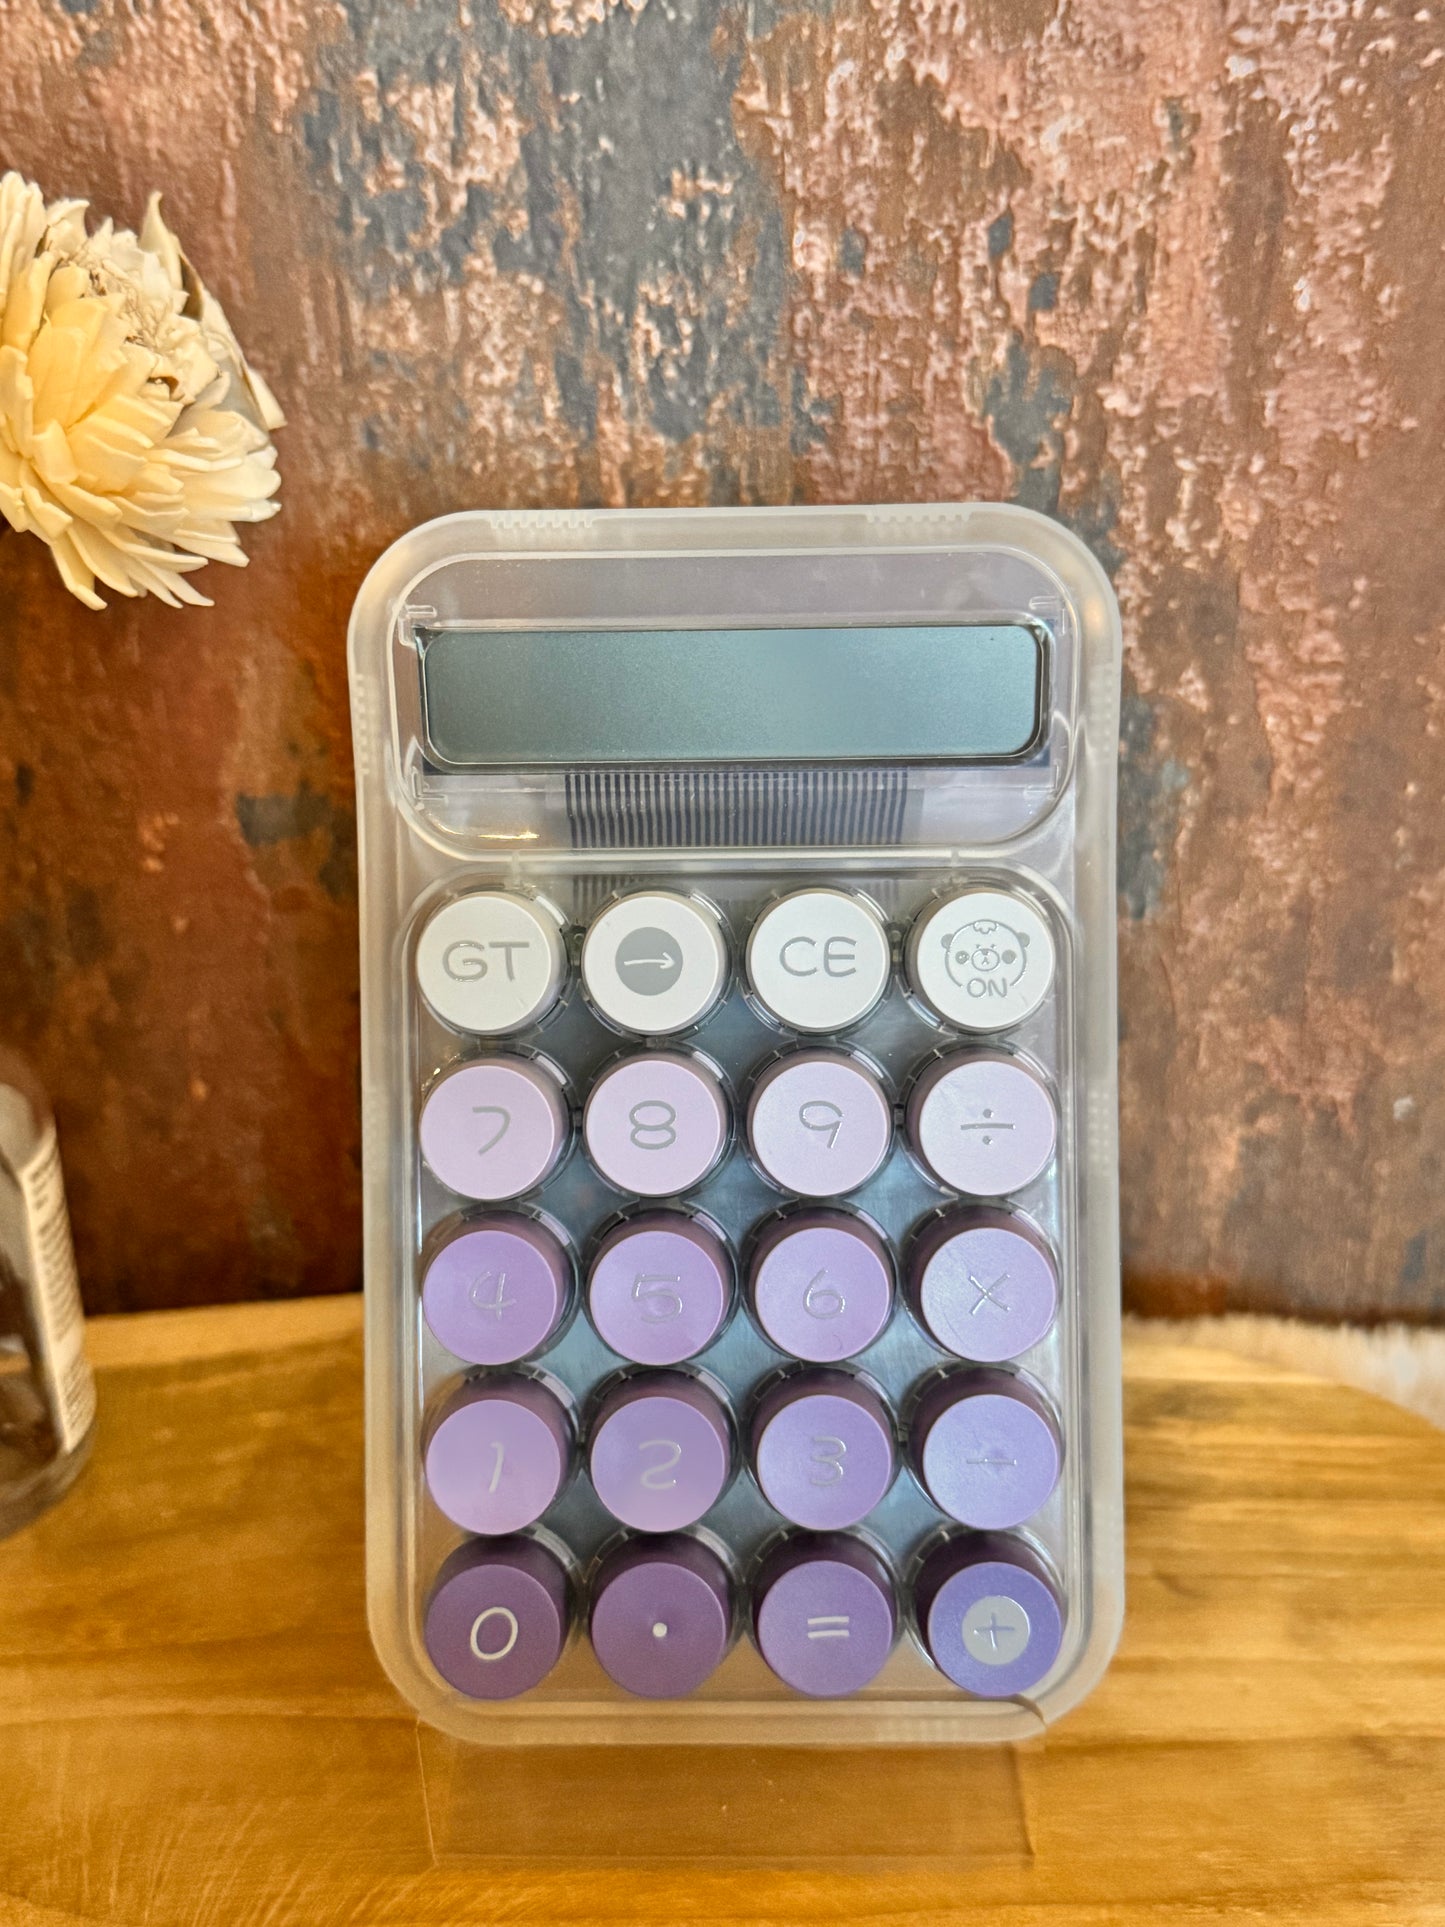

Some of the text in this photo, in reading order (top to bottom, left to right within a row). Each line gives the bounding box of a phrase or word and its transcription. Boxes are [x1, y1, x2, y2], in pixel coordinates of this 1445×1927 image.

[442, 940, 530, 982] GT
[779, 936, 856, 977] CE
[967, 977, 1008, 998] ON
[472, 1105, 511, 1156] 7
[629, 1100, 676, 1150] 8
[799, 1100, 844, 1149] 9
[468, 1271, 517, 1320] 4
[631, 1273, 682, 1324] 5
[803, 1268, 845, 1319] 6
[488, 1439, 504, 1494] 1
[639, 1439, 682, 1490] 2
[810, 1436, 847, 1488] 3
